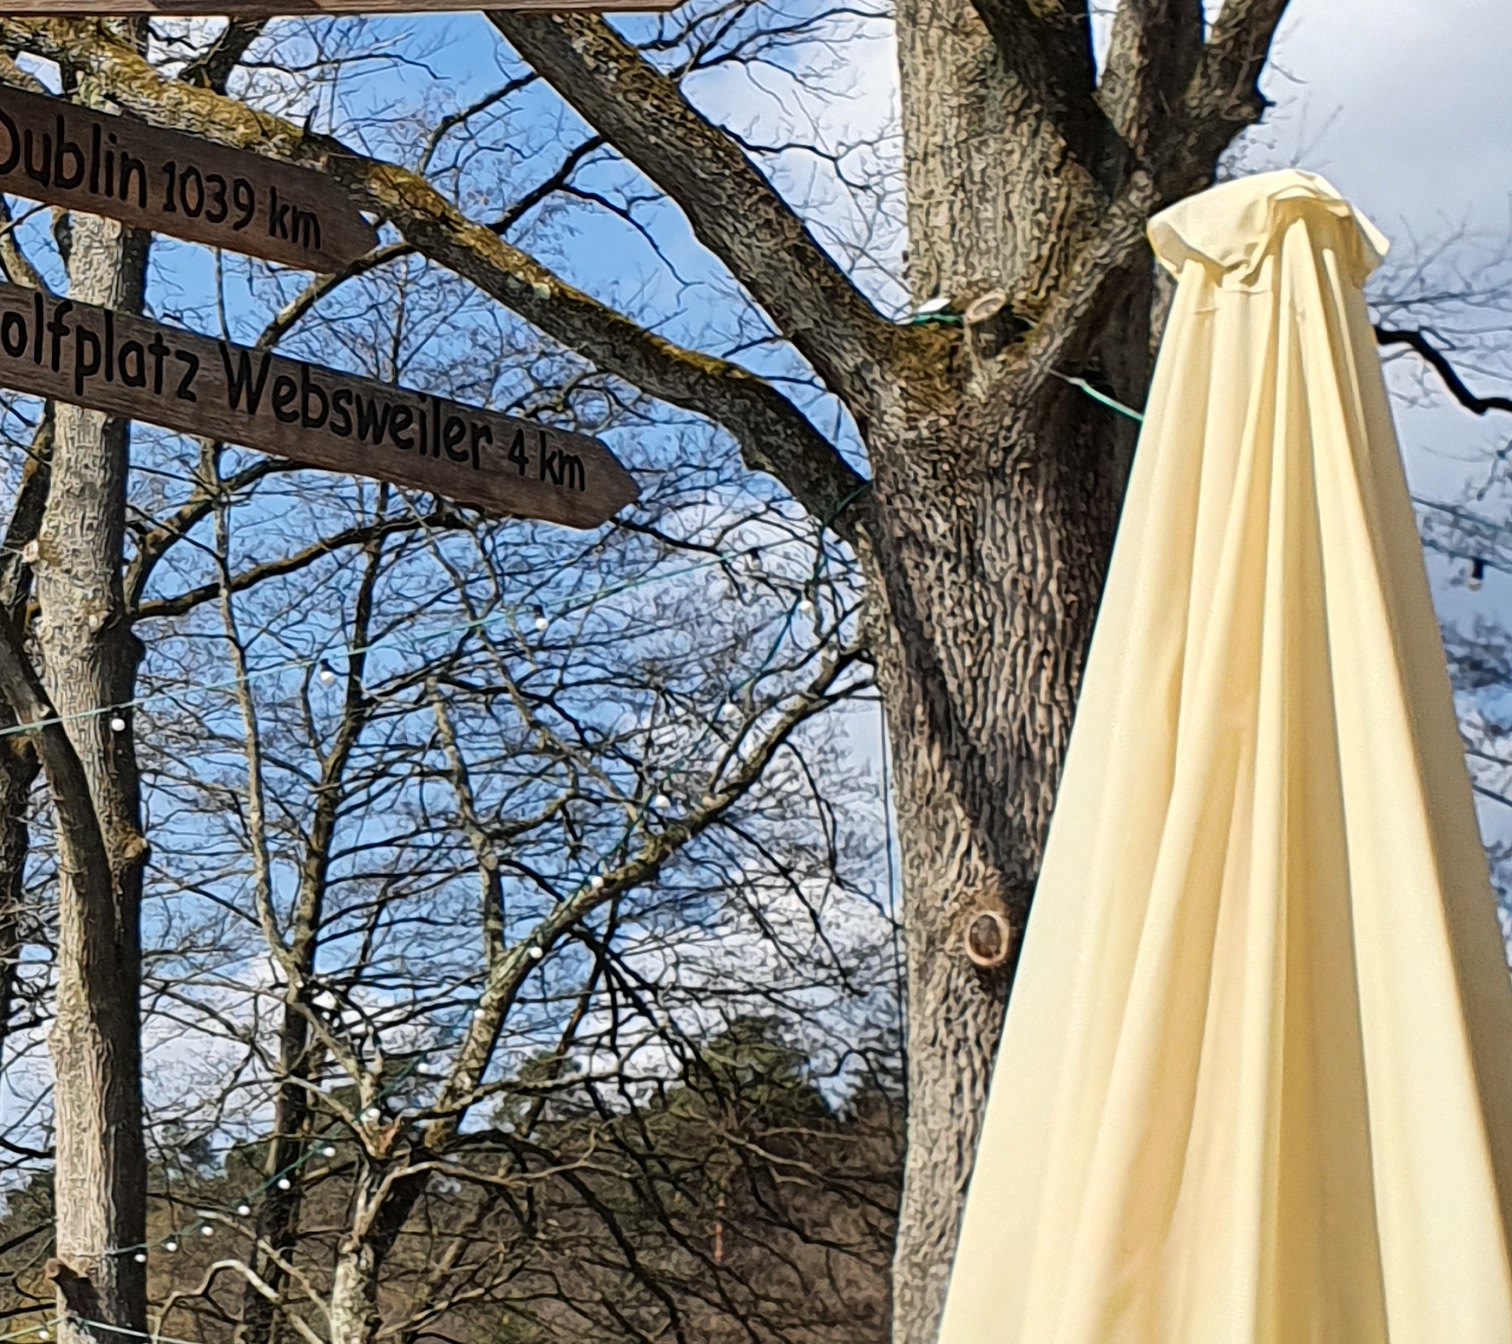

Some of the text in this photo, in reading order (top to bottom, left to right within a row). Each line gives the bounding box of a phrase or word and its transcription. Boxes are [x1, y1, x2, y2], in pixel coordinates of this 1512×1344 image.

[163, 160, 257, 230] 1039
[269, 186, 321, 251] km
[219, 339, 493, 471] Websweiler
[508, 428, 530, 476] 4
[539, 435, 586, 491] km
